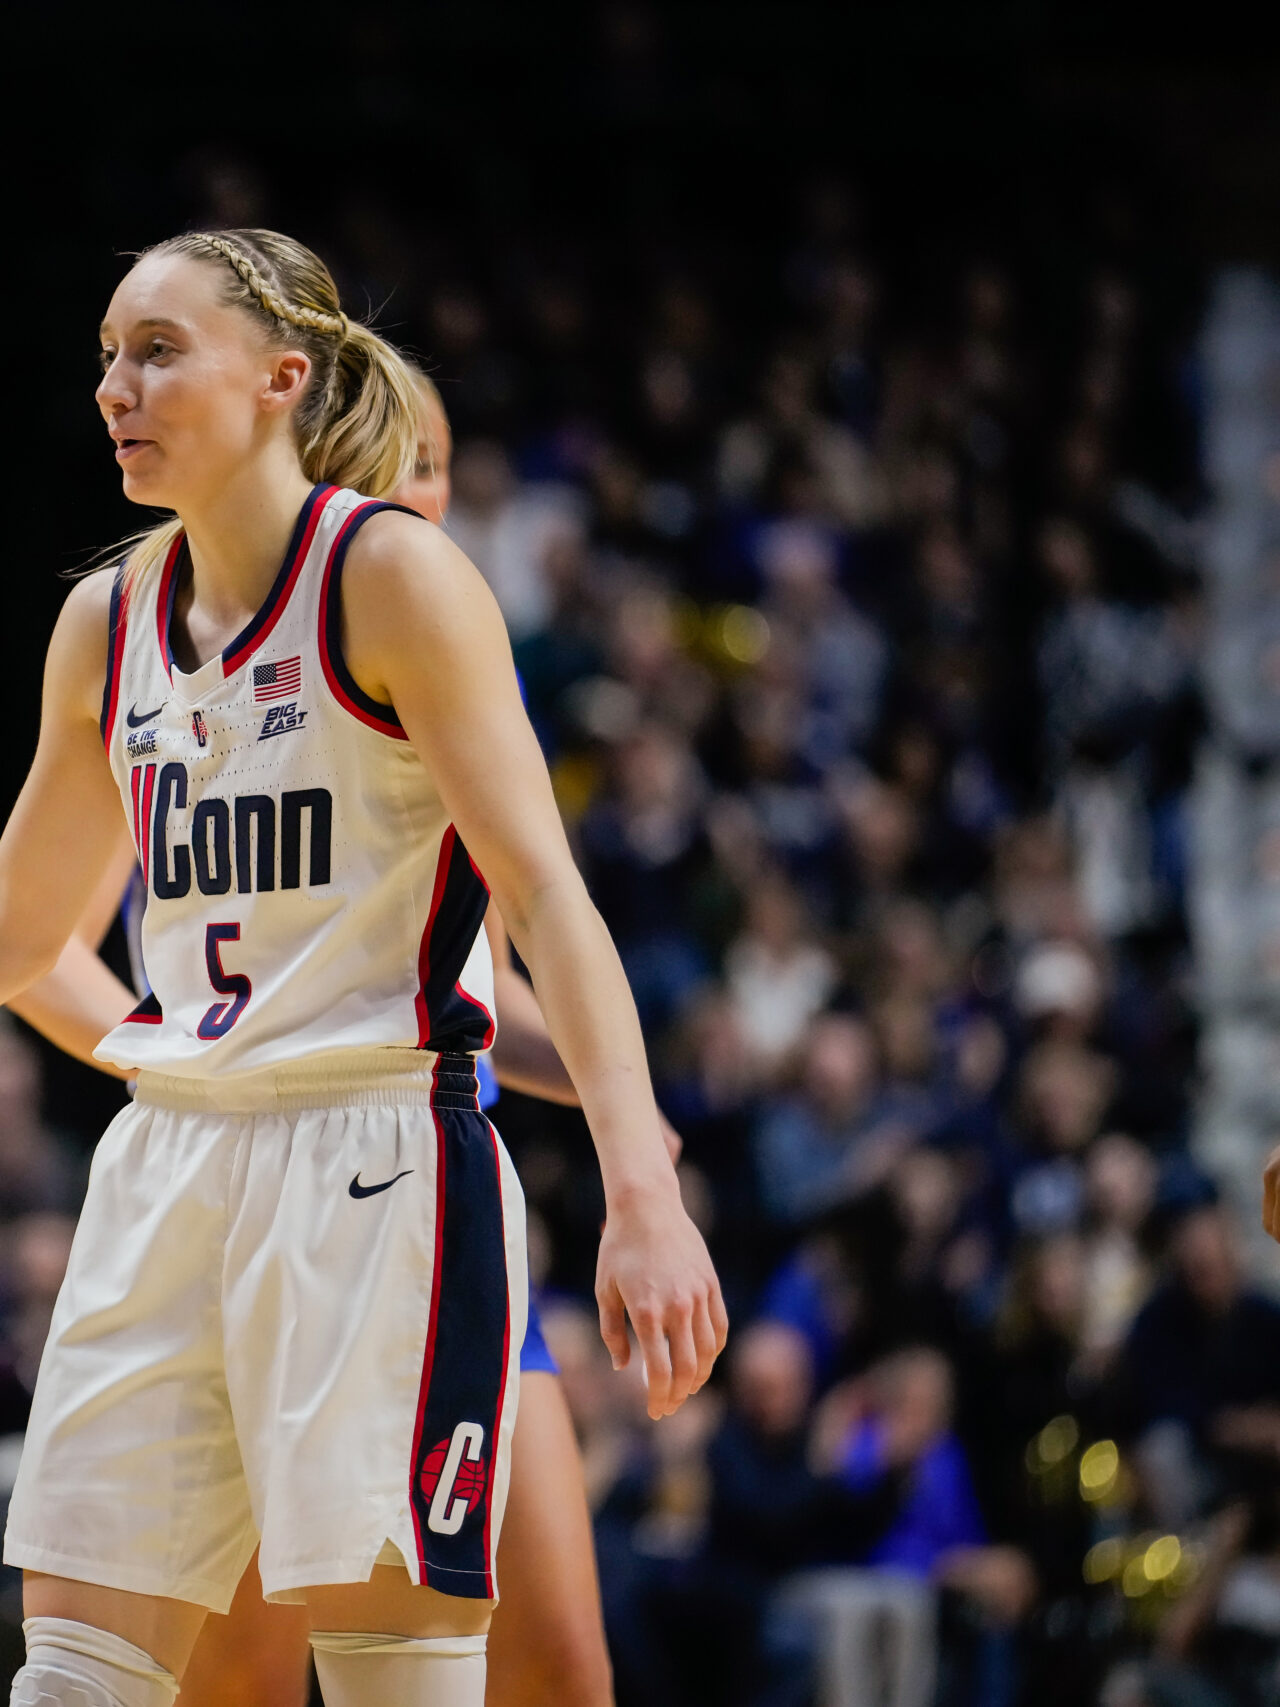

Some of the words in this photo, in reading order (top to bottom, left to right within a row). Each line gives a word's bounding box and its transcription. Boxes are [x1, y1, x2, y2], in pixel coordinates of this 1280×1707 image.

[261, 711, 308, 734] EAST
[265, 701, 297, 721] BIG
[127, 732, 140, 746] BE
[140, 728, 160, 742] THE
[127, 740, 158, 758] CHANGE
[131, 762, 332, 900] UConn
[197, 922, 252, 1040] 5
[428, 1421, 484, 1536] C
